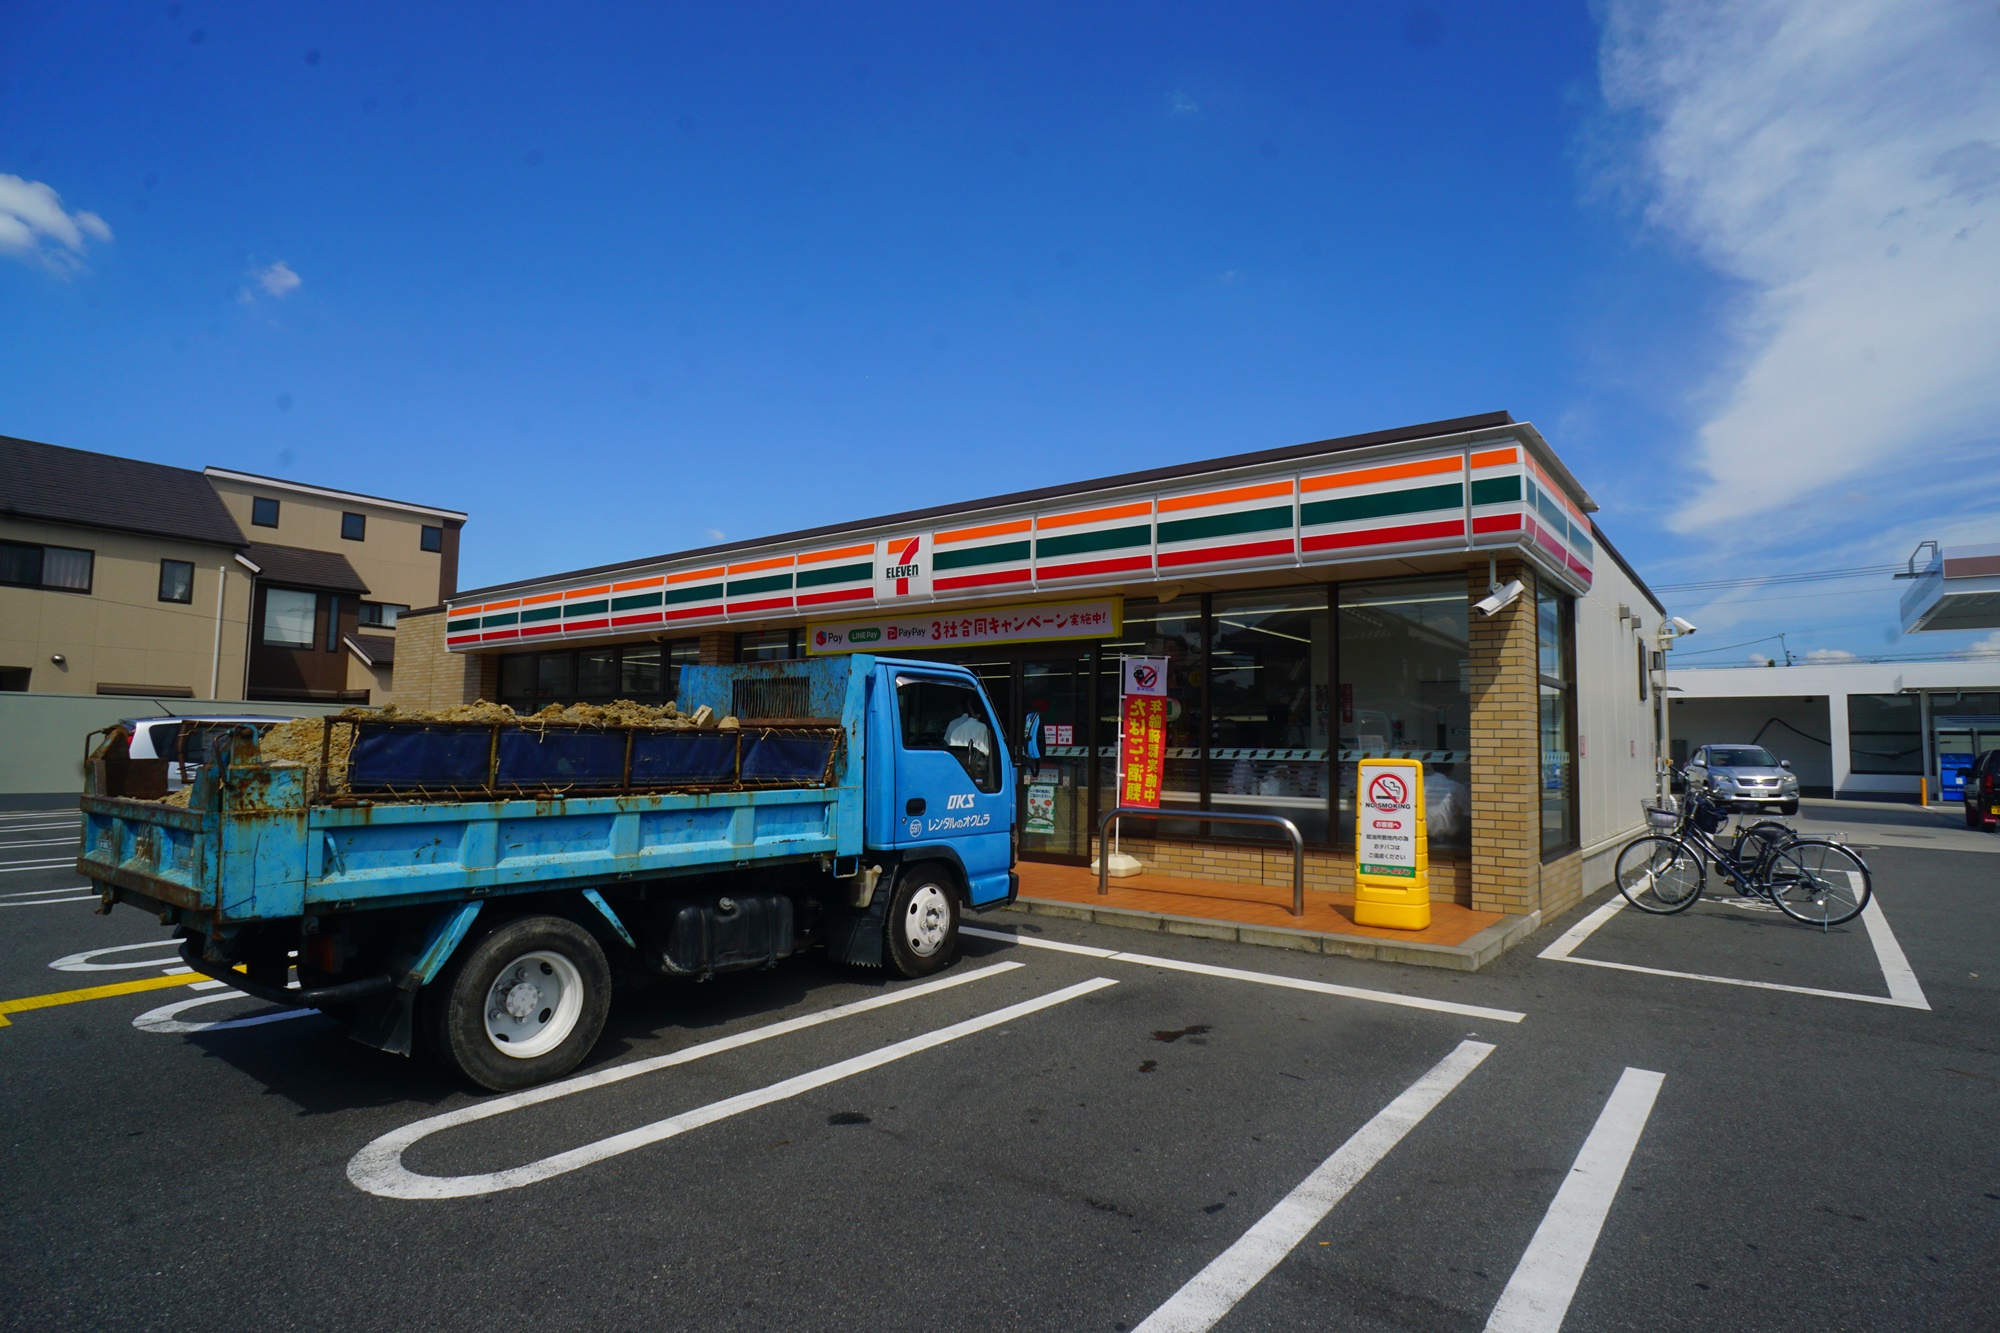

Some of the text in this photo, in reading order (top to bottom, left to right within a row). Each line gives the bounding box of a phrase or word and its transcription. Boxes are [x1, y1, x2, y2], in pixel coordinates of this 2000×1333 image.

[828, 632, 843, 644] Pay
[851, 631, 878, 640] LINE Pay
[898, 628, 926, 638] PayPay
[928, 814, 990, 832] レンタルのオクムラ
